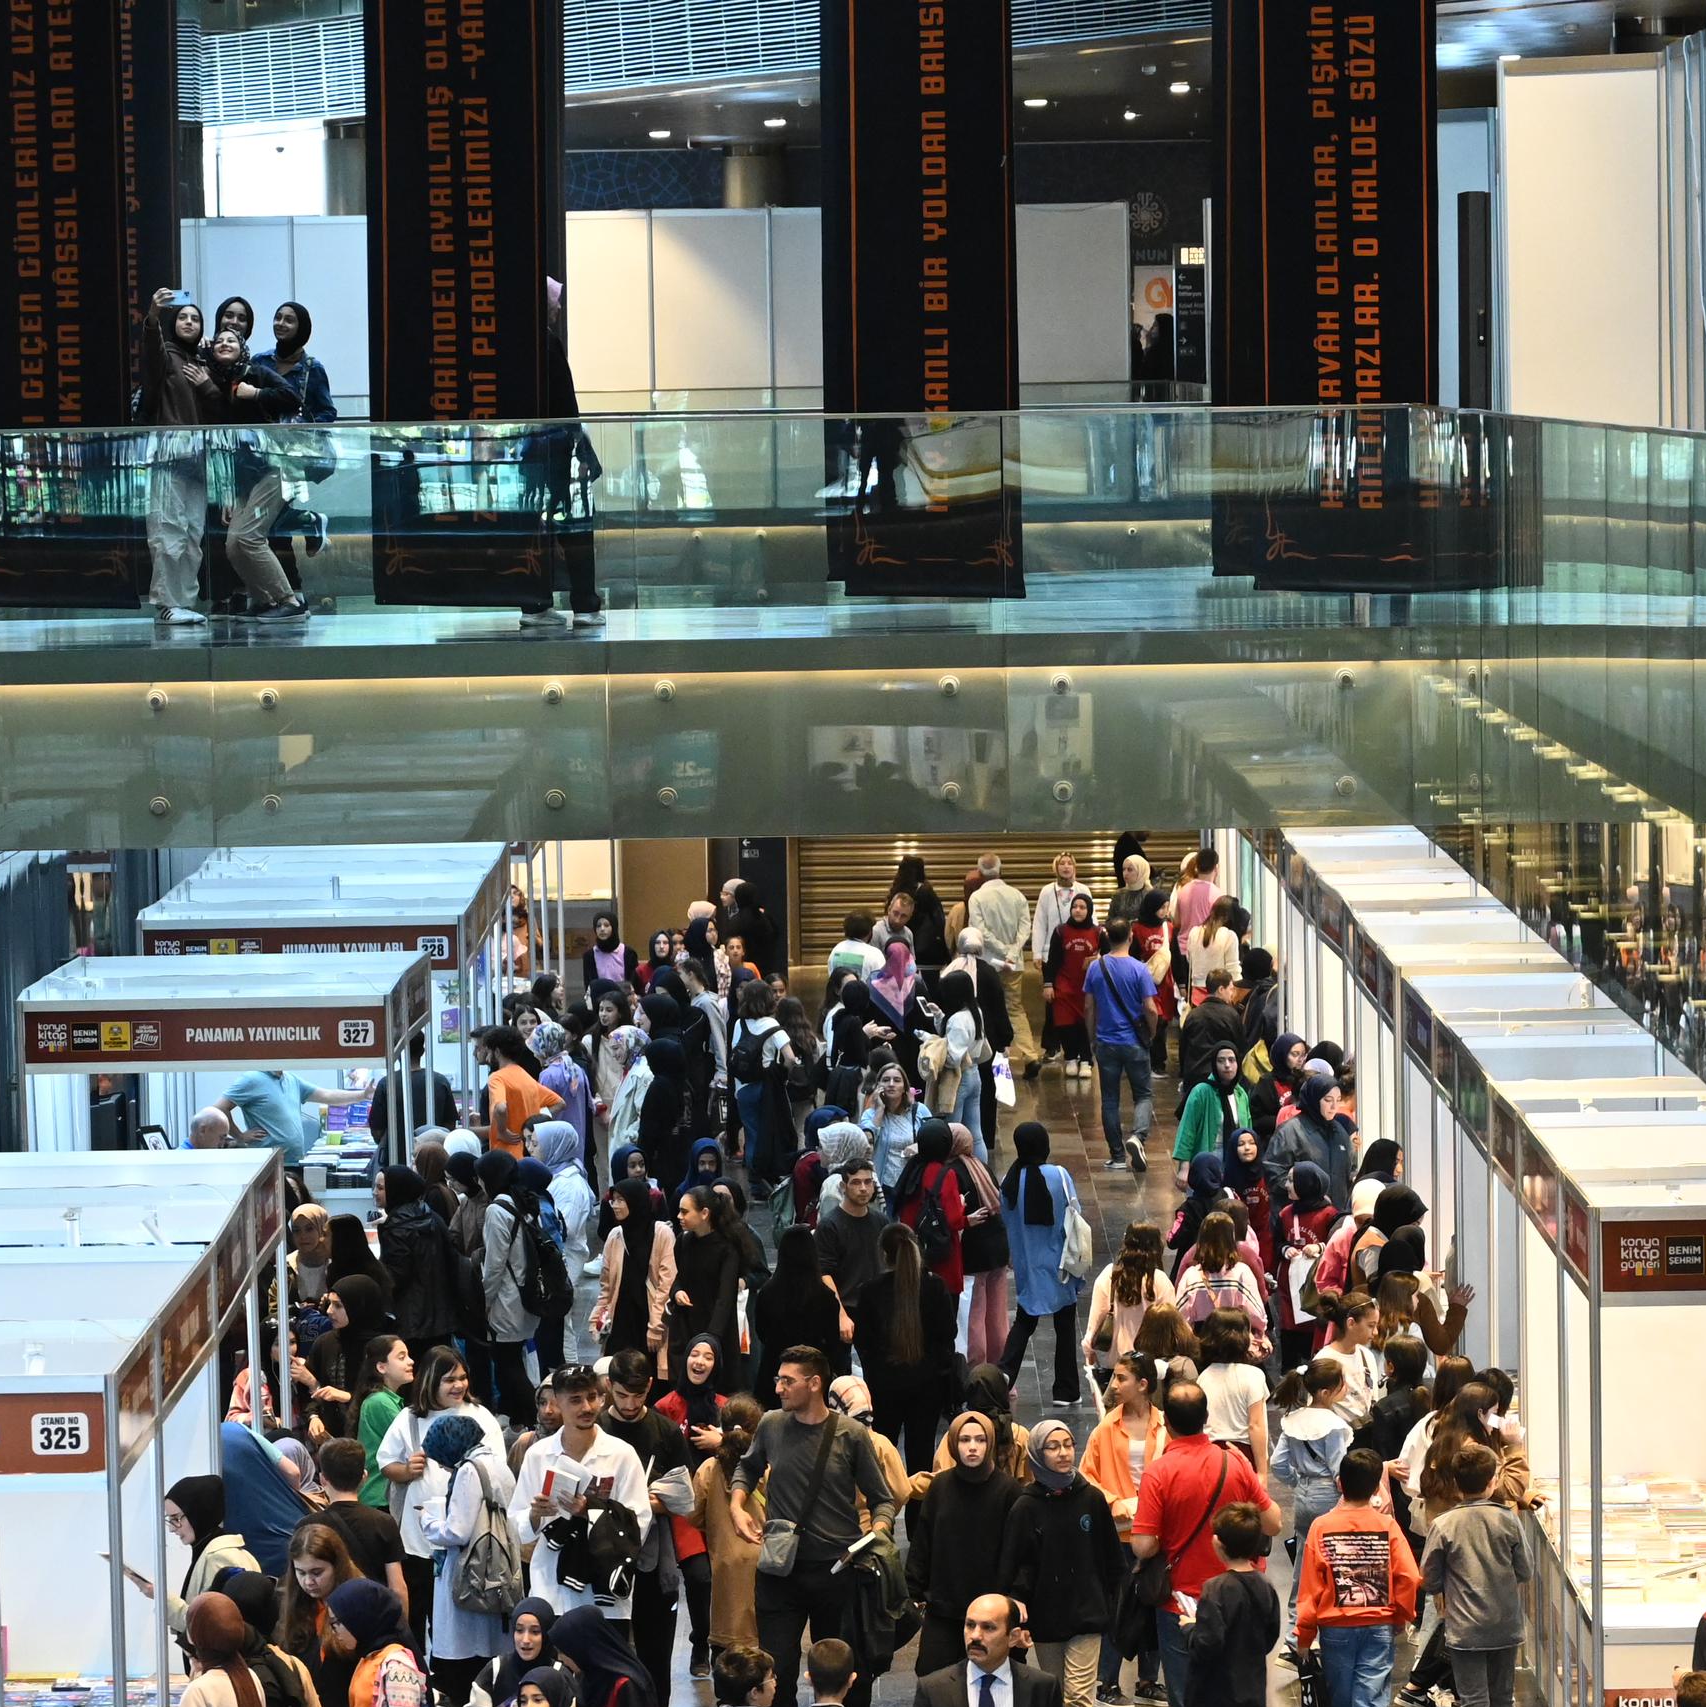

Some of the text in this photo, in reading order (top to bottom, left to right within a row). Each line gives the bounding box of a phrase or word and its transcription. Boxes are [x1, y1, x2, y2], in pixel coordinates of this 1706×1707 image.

[1305, 5, 1339, 118] PİŞKİN
[1344, 15, 1377, 101] SÖZÜ
[48, 87, 76, 173] OLAN
[10, 71, 41, 278] GÜNLERİMİZ
[424, 85, 454, 252] AYRILMIŞ
[920, 110, 948, 242] YOLDAN
[1350, 116, 1377, 221] HALDE
[459, 97, 496, 356] PERDELERİMİZİ
[1311, 133, 1339, 294] OLANLAR,
[51, 188, 80, 309] HÂSSIL
[1352, 237, 1379, 257] O
[918, 256, 949, 312] BİR
[20, 293, 47, 399] GEÇEN
[38, 1022, 67, 1035] konya
[38, 1031, 67, 1042] kitap
[185, 1026, 244, 1043] PANAMA
[342, 1028, 370, 1044] 327
[1620, 1236, 1660, 1250] konya
[1620, 1248, 1660, 1261] kitap
[1668, 1245, 1702, 1255] BENİM
[1668, 1256, 1702, 1266] ŞEHRİM
[1620, 1259, 1660, 1271] günleri
[39, 1426, 81, 1450] 325
[40, 1416, 79, 1425] STAND NO
